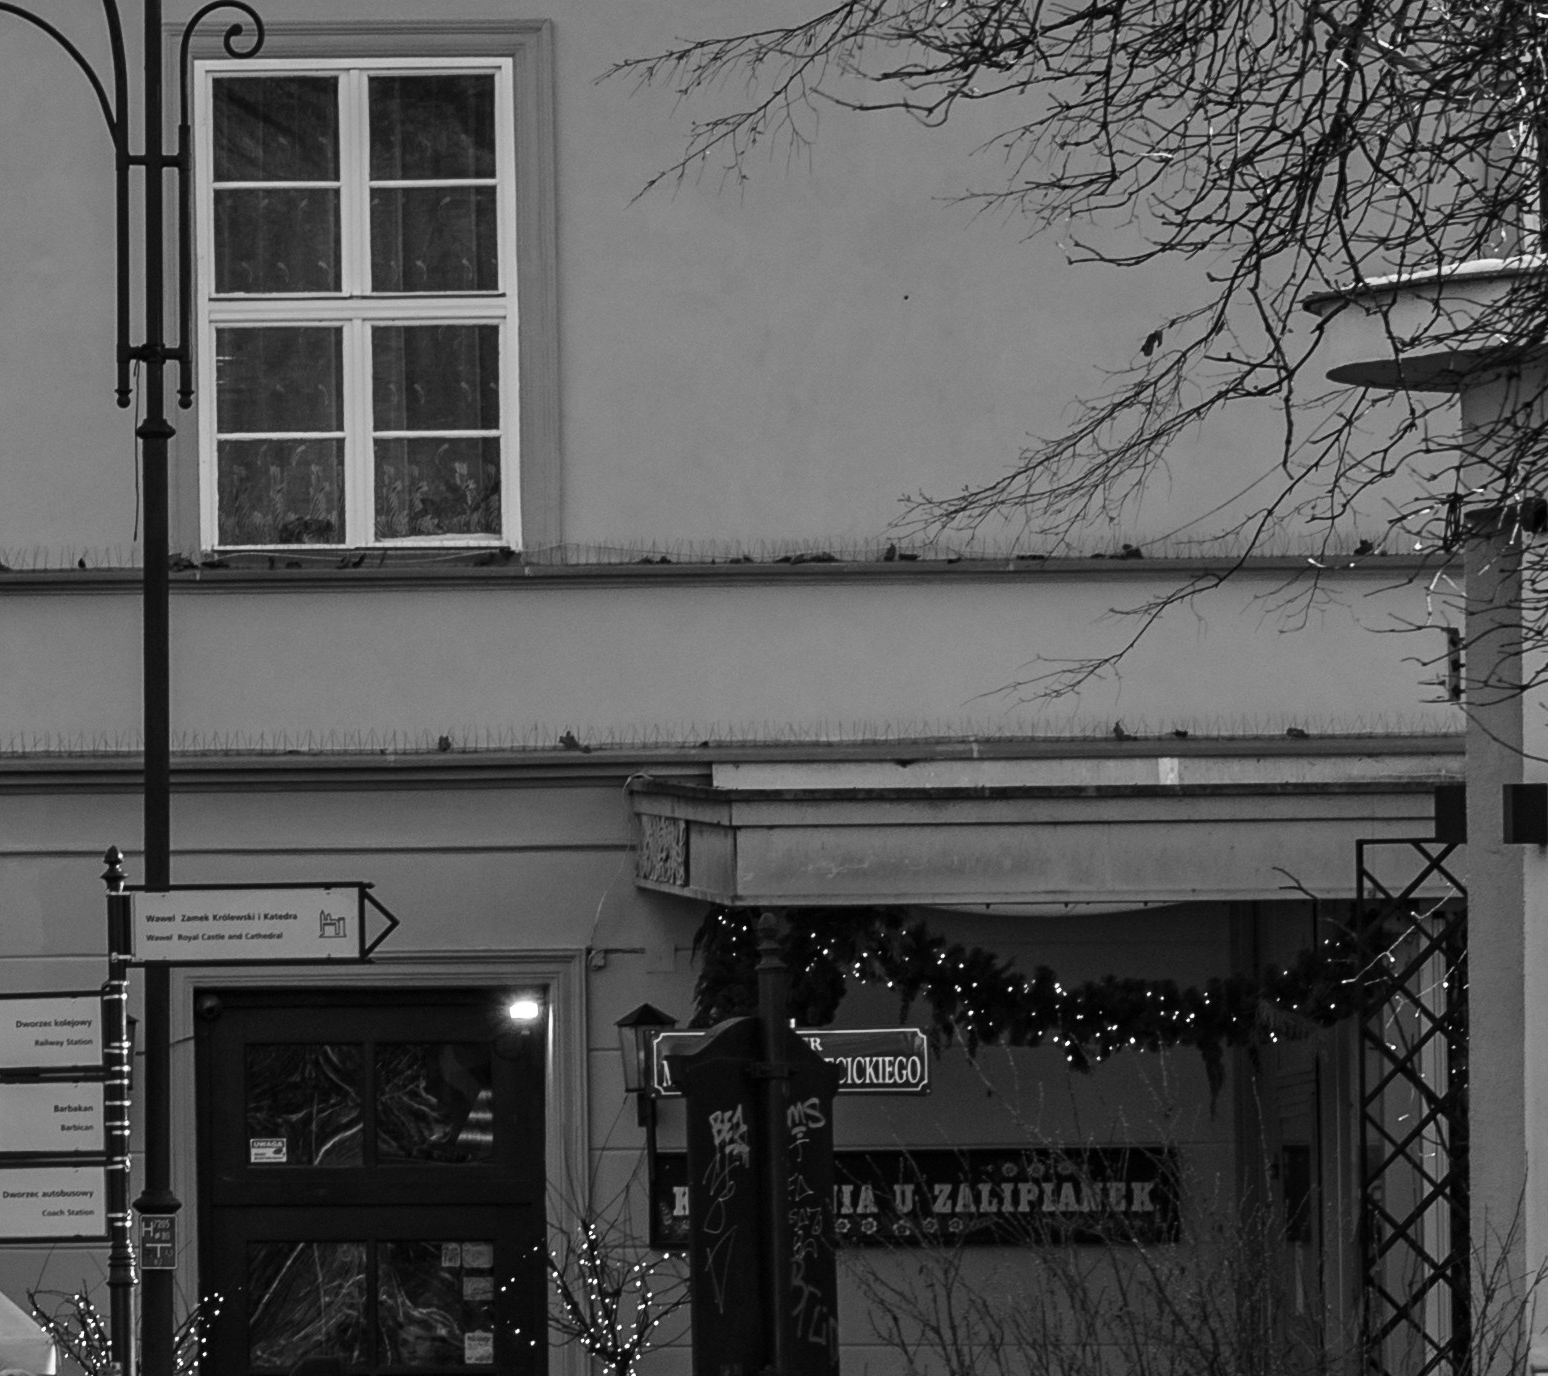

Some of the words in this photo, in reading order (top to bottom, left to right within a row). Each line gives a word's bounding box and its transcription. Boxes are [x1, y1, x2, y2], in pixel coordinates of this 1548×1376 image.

[145, 914, 175, 922] Wawel
[181, 913, 209, 922] Zamek
[212, 912, 255, 921] Królewski
[263, 912, 298, 920] Katedra
[177, 933, 199, 942] Royal
[201, 933, 225, 941] Castle
[245, 931, 283, 940] Cathedral
[15, 1020, 52, 1028] Dworzec
[54, 1018, 93, 1029] kolejowy
[34, 1039, 64, 1047] Railway
[66, 1037, 93, 1046] Station
[824, 1056, 921, 1084] CICKIEGO
[53, 1104, 93, 1113] Barbakan
[60, 1124, 94, 1132] Barbican
[2, 1190, 39, 1199] Dworzec
[42, 1189, 94, 1199] autobusowy
[893, 1185, 914, 1213] U
[933, 1182, 1155, 1214] ZALIPIANEK
[42, 1209, 65, 1217] Coach
[67, 1208, 95, 1217] Station
